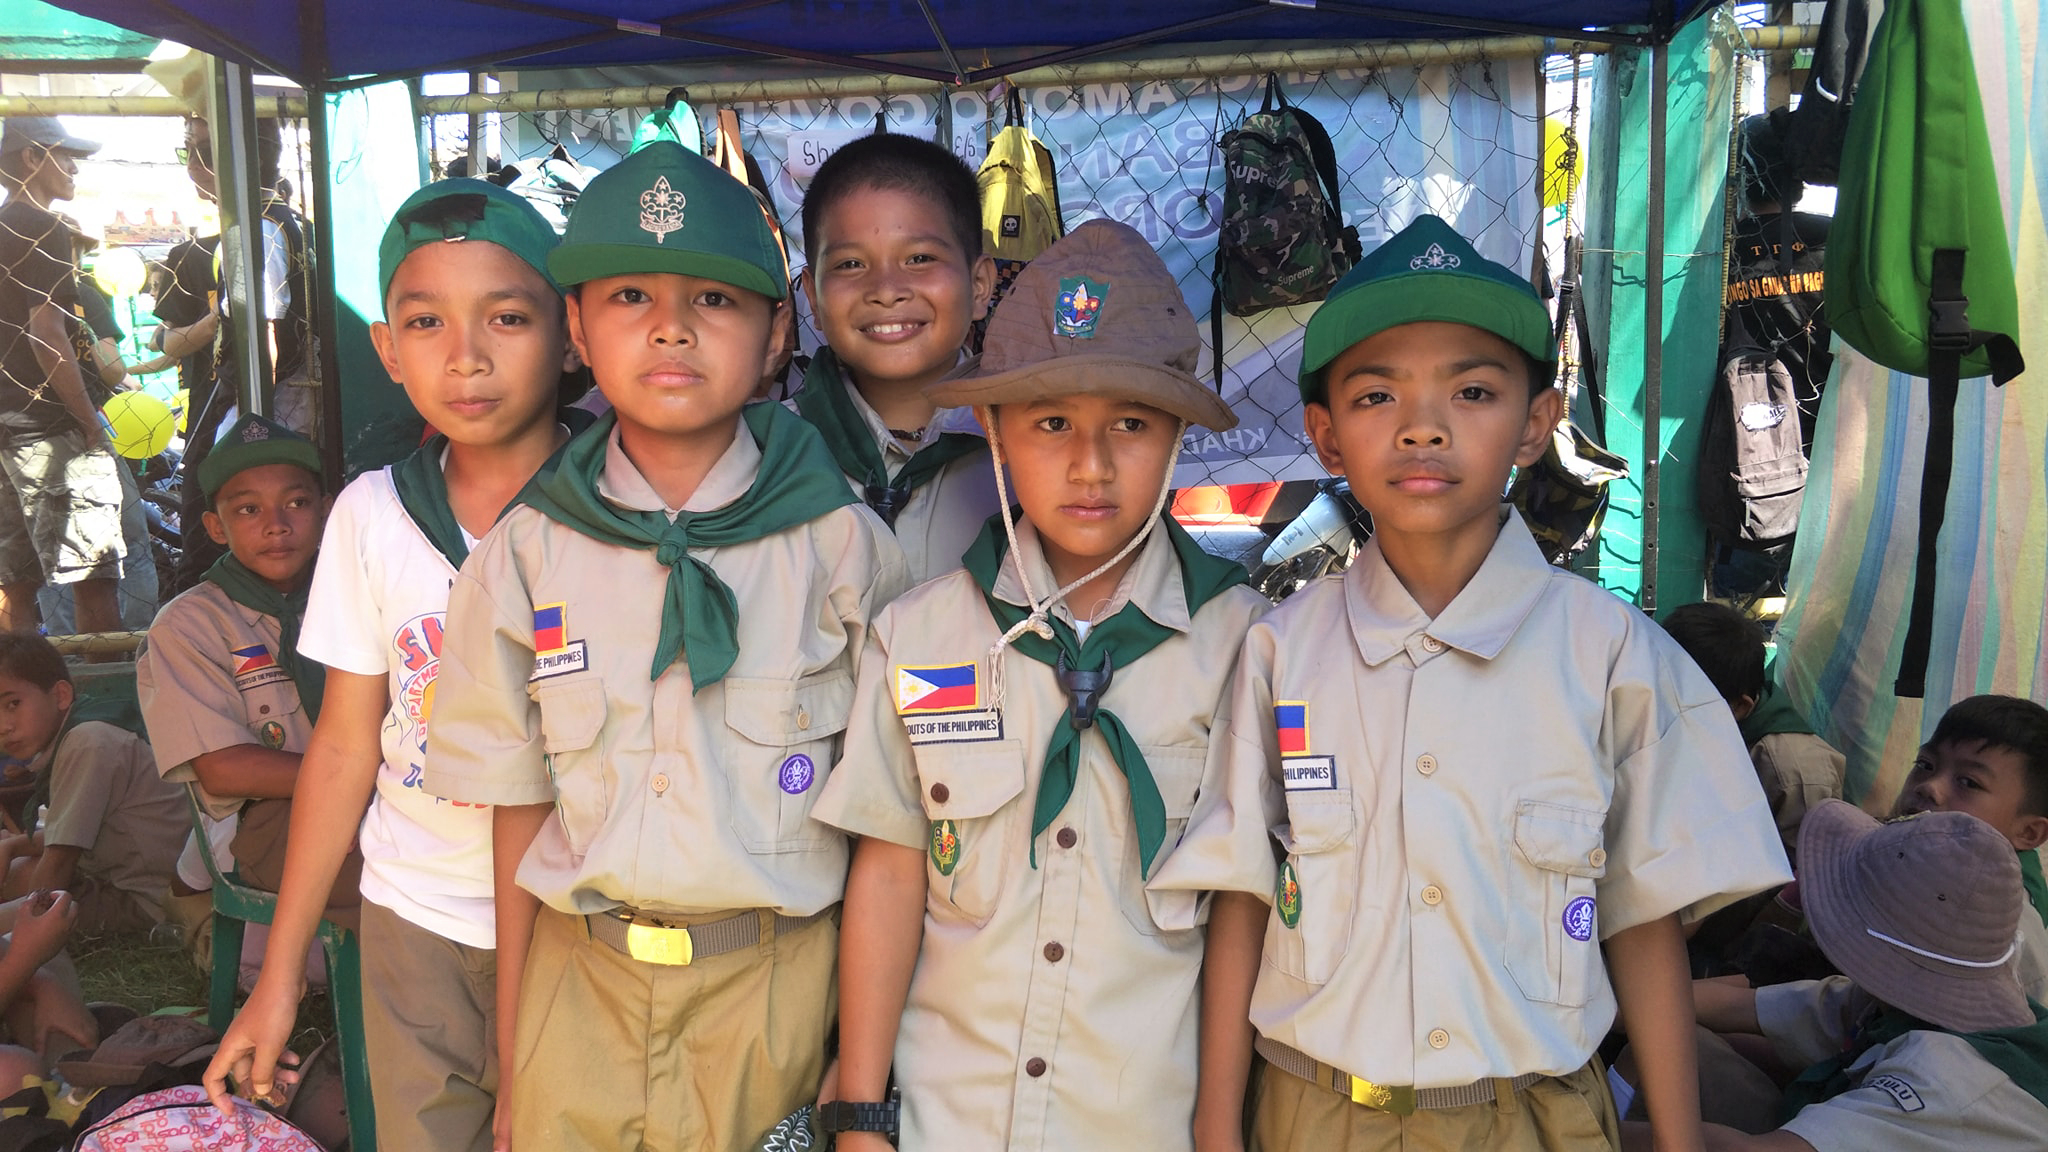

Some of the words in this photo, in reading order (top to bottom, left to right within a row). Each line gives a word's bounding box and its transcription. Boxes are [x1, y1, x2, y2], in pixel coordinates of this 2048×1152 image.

[1277, 265, 1315, 286] Supreme
[544, 650, 582, 668] PHILIPPINES
[926, 723, 936, 734] OF
[937, 721, 951, 733] THE
[951, 719, 997, 732] PHILIPPINES
